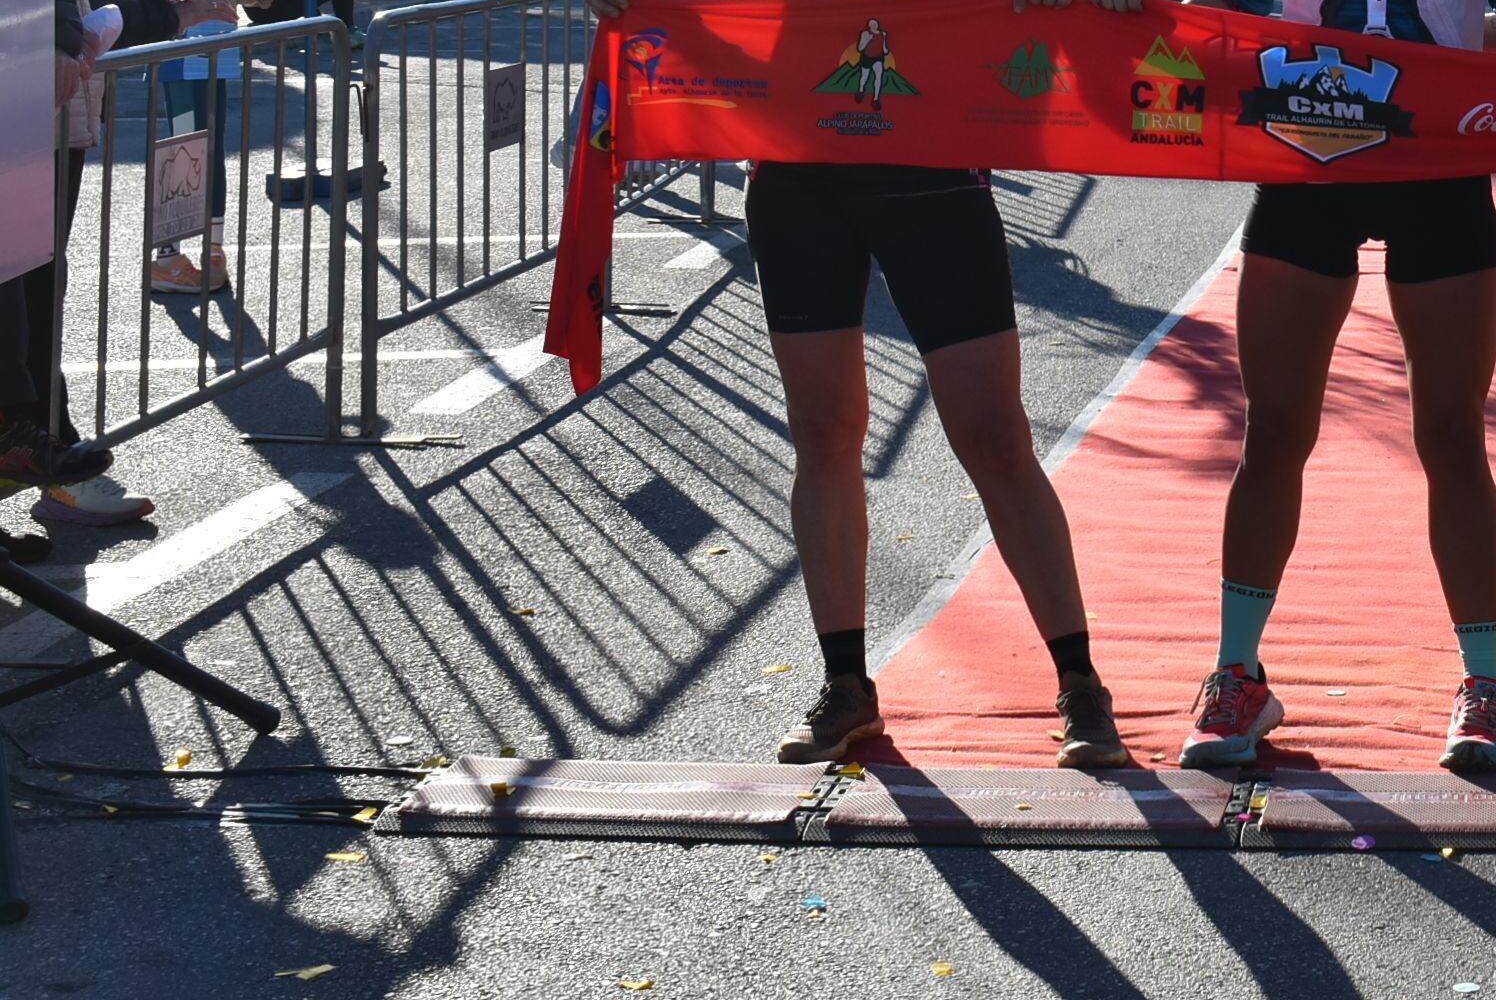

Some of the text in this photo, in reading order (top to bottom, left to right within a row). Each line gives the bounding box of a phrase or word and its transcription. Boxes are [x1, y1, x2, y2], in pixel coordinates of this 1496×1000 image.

[1130, 80, 1206, 114] CXM
[1287, 96, 1364, 120] CxM
[817, 119, 847, 128] ALPINO
[1138, 112, 1196, 131] TRAIL
[1266, 112, 1289, 122] TRAIL
[1333, 118, 1345, 127] DE
[1347, 119, 1358, 128] LA
[1130, 132, 1205, 146] ANDALUCÍA
